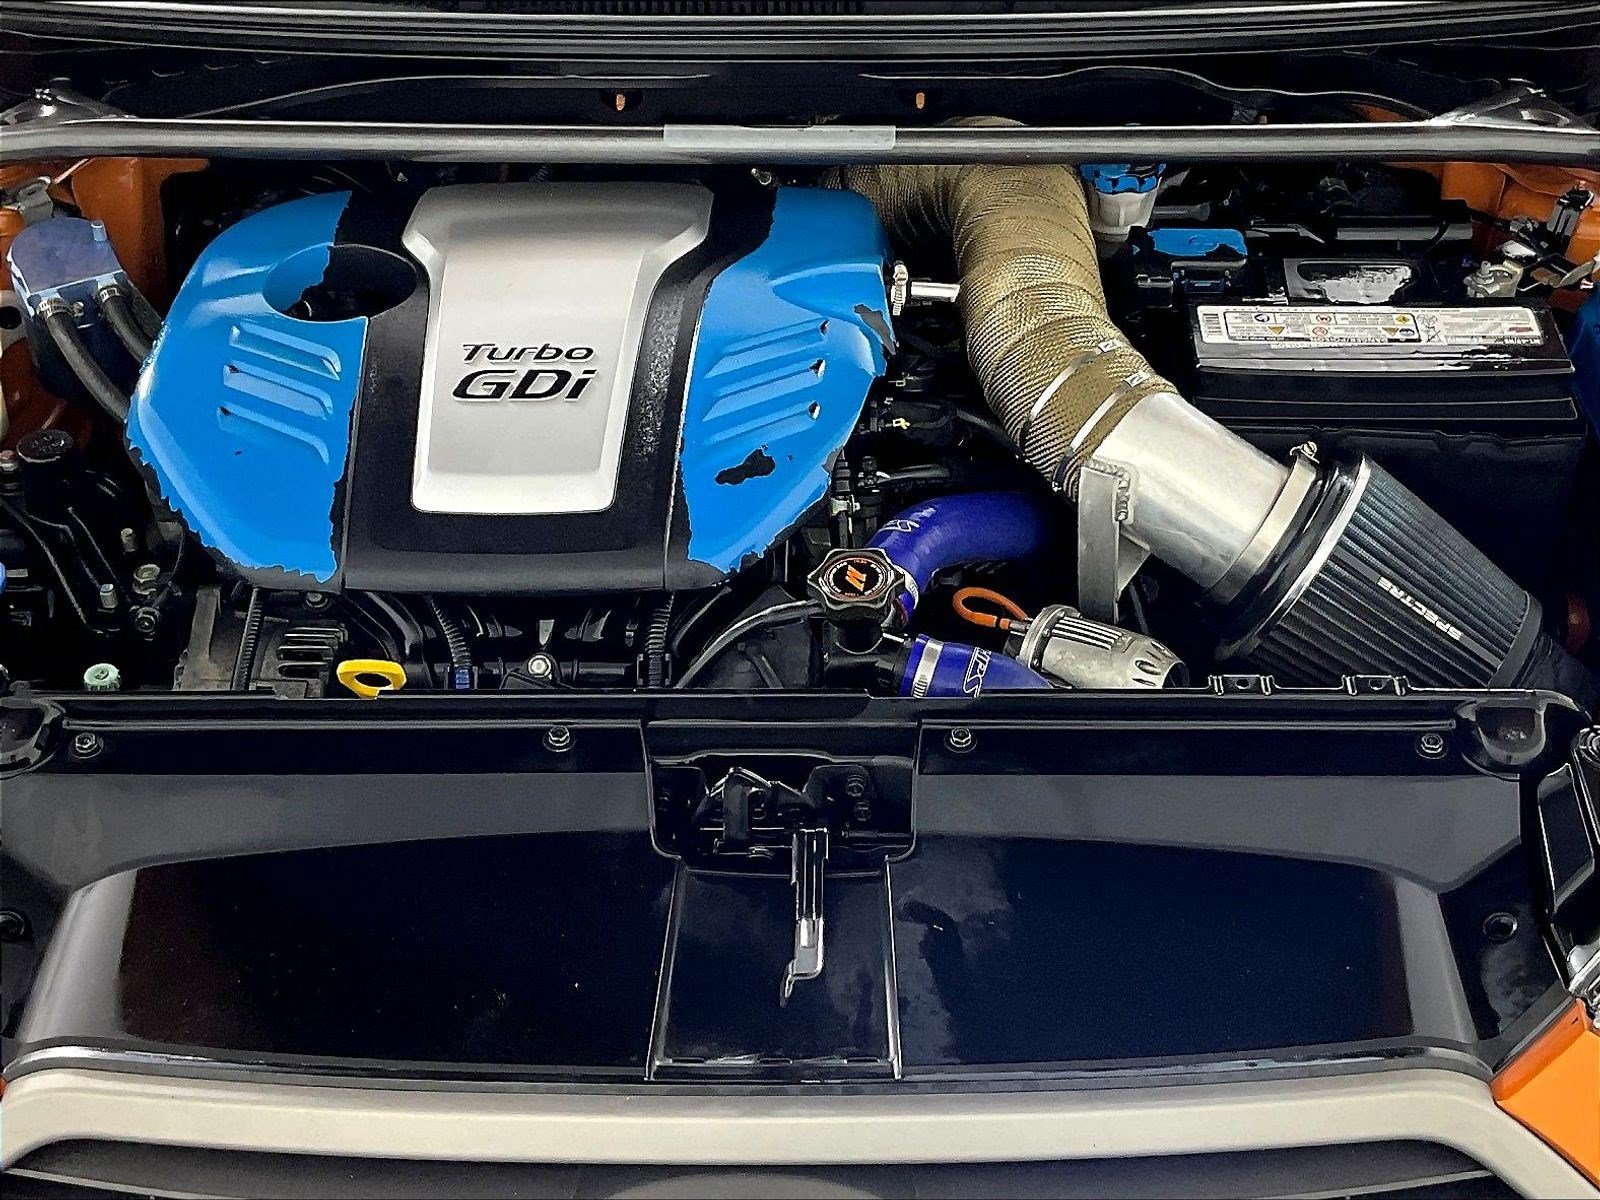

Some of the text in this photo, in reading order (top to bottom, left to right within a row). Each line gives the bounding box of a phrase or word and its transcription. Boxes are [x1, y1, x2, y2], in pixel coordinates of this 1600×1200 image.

[462, 343, 595, 363] Turbo
[452, 369, 598, 401] GDi
[1377, 576, 1462, 641] SPECTRE
